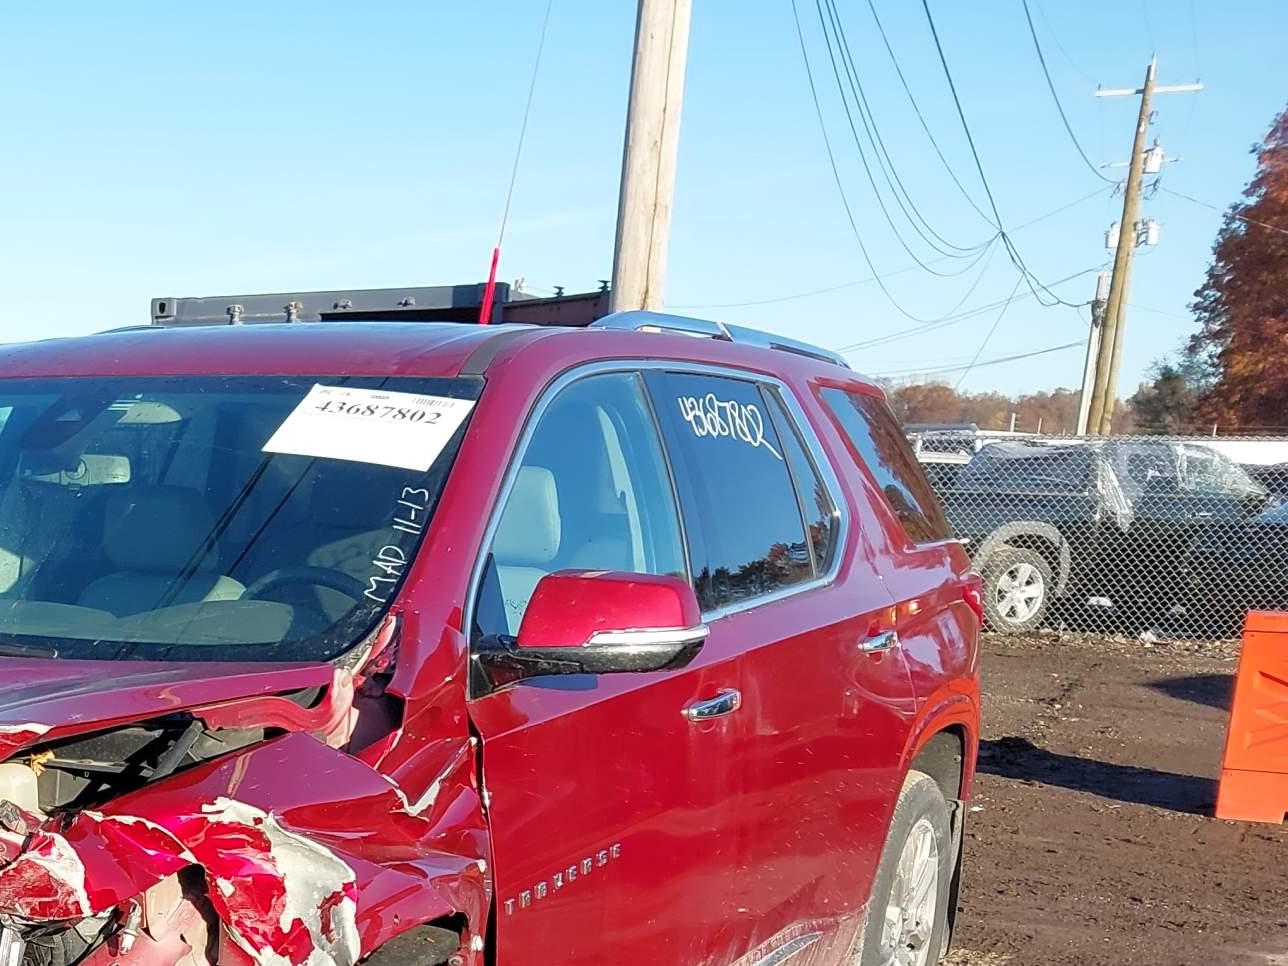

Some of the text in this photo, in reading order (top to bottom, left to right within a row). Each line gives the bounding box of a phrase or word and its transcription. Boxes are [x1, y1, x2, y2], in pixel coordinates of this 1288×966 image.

[315, 399, 442, 425] 43687802
[363, 486, 429, 603] MAD 11-13
[503, 843, 622, 916] TRAVERSE
